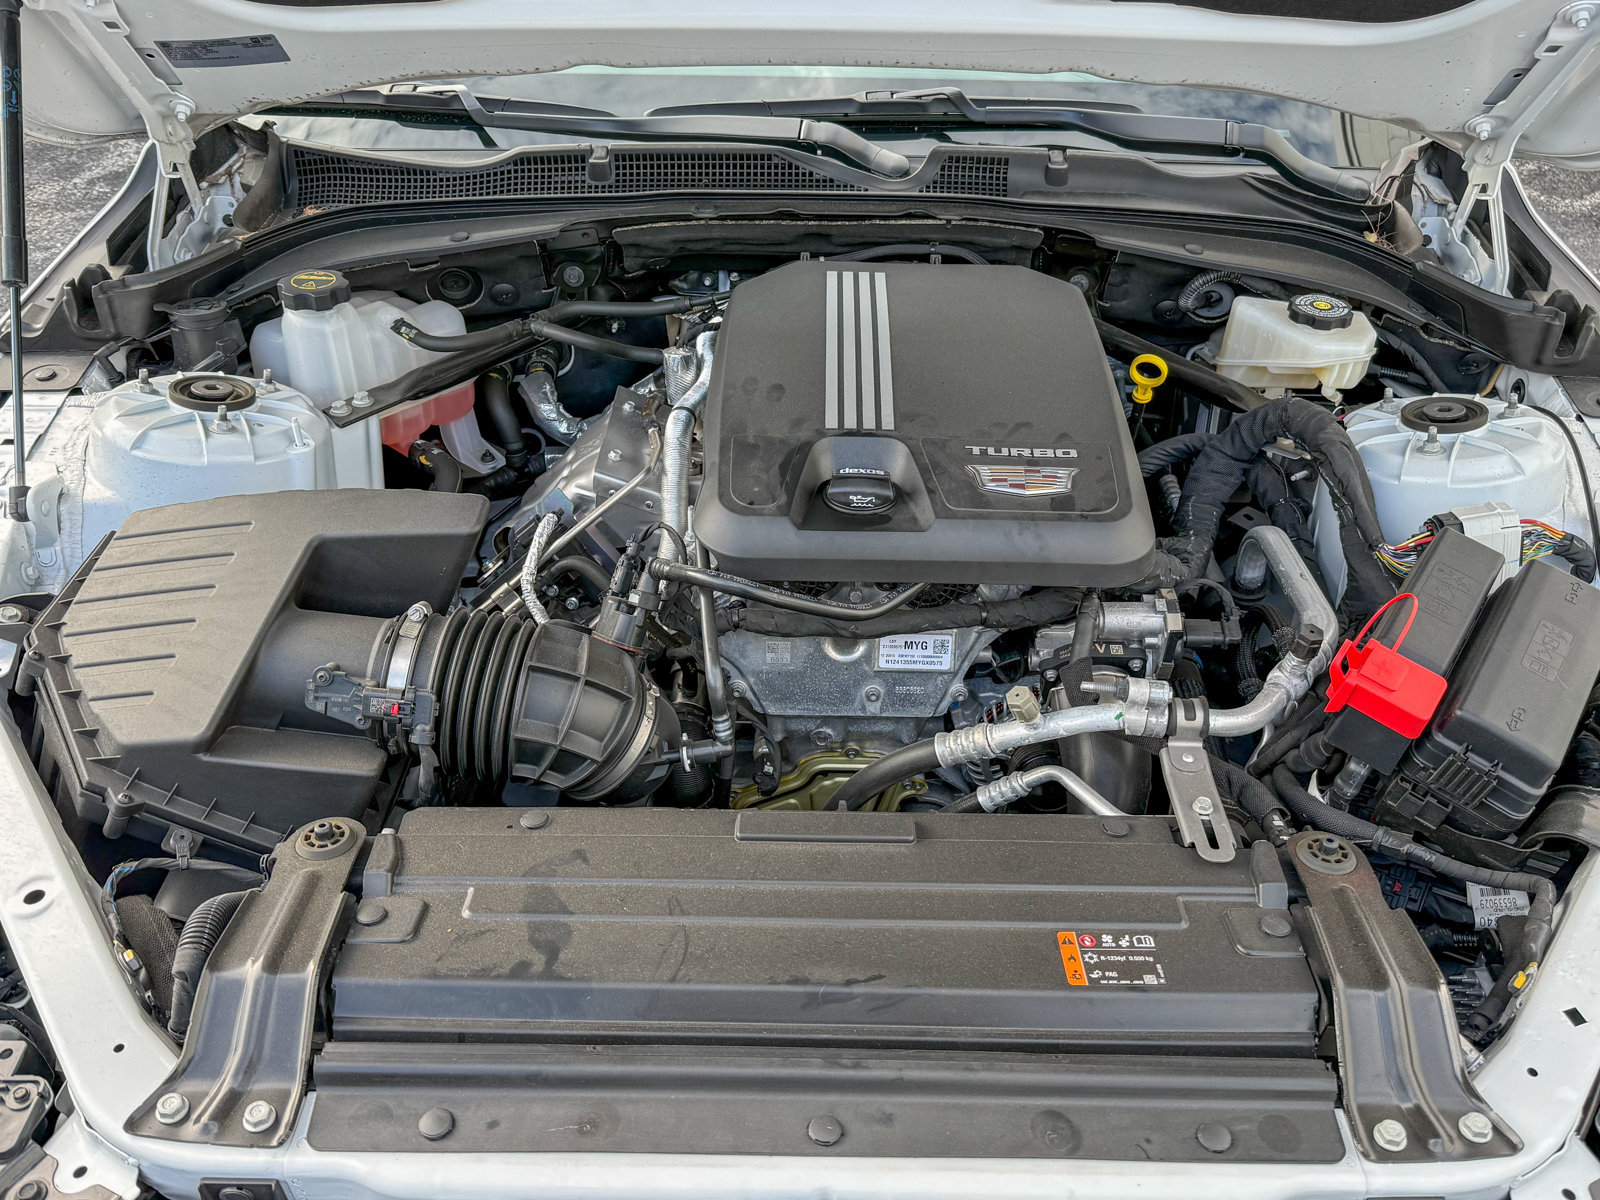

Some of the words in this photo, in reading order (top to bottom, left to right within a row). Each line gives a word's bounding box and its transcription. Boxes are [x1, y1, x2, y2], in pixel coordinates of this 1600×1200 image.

[965, 446, 1078, 458] TURBO
[839, 467, 885, 475] dexos
[903, 640, 928, 651] MYG
